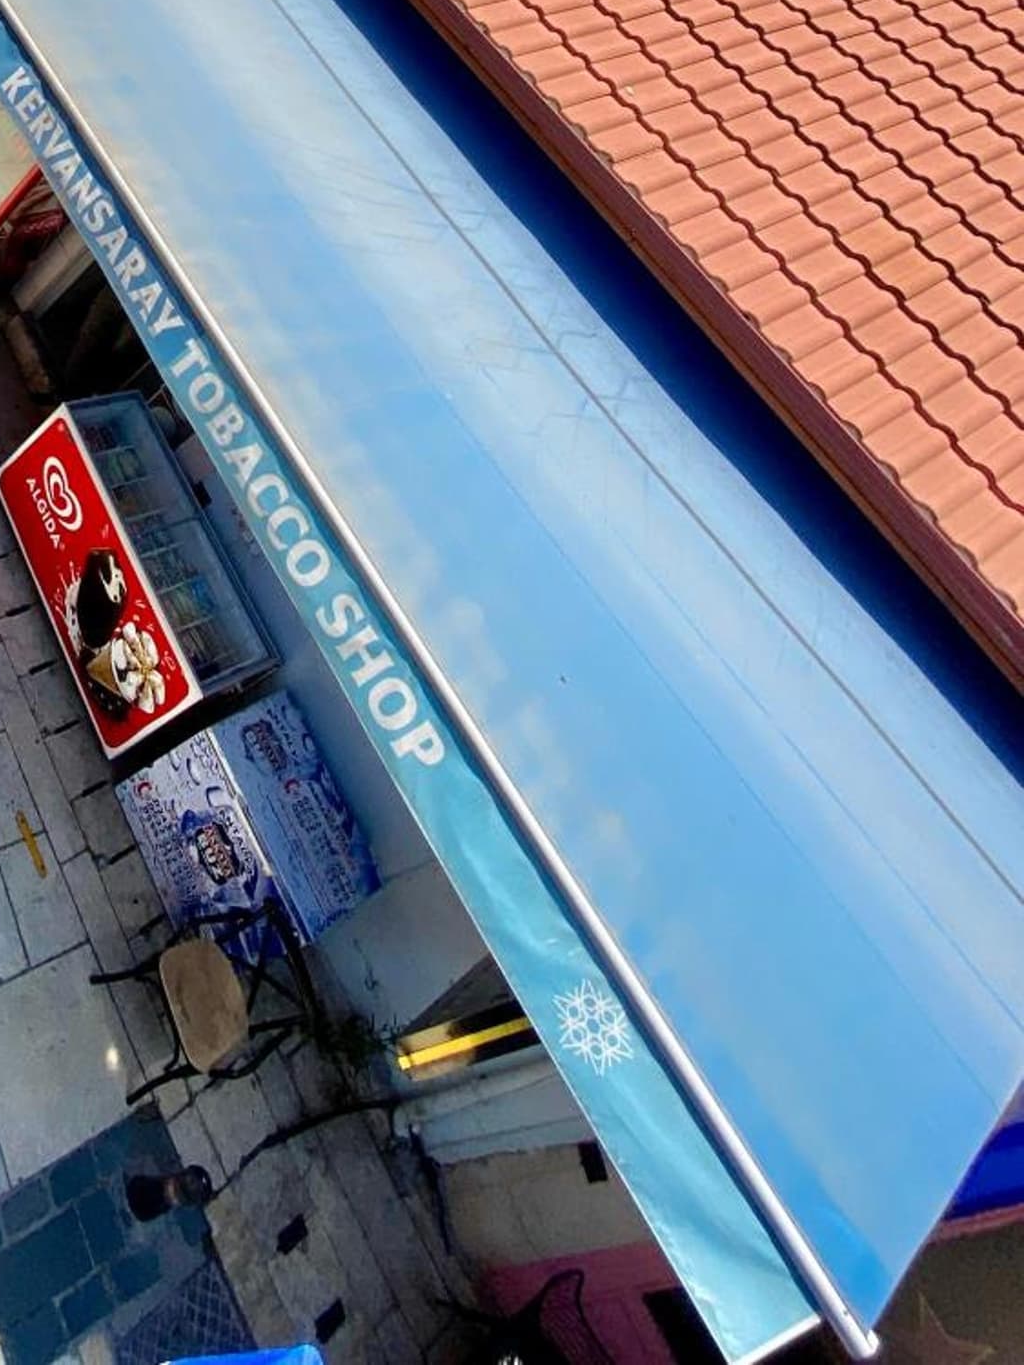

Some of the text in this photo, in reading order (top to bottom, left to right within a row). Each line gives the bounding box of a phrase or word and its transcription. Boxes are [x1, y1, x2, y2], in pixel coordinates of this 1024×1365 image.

[2, 65, 445, 766] KERVANSARAY TOBACCO SHOP
[26, 478, 61, 548] ALGIDA
